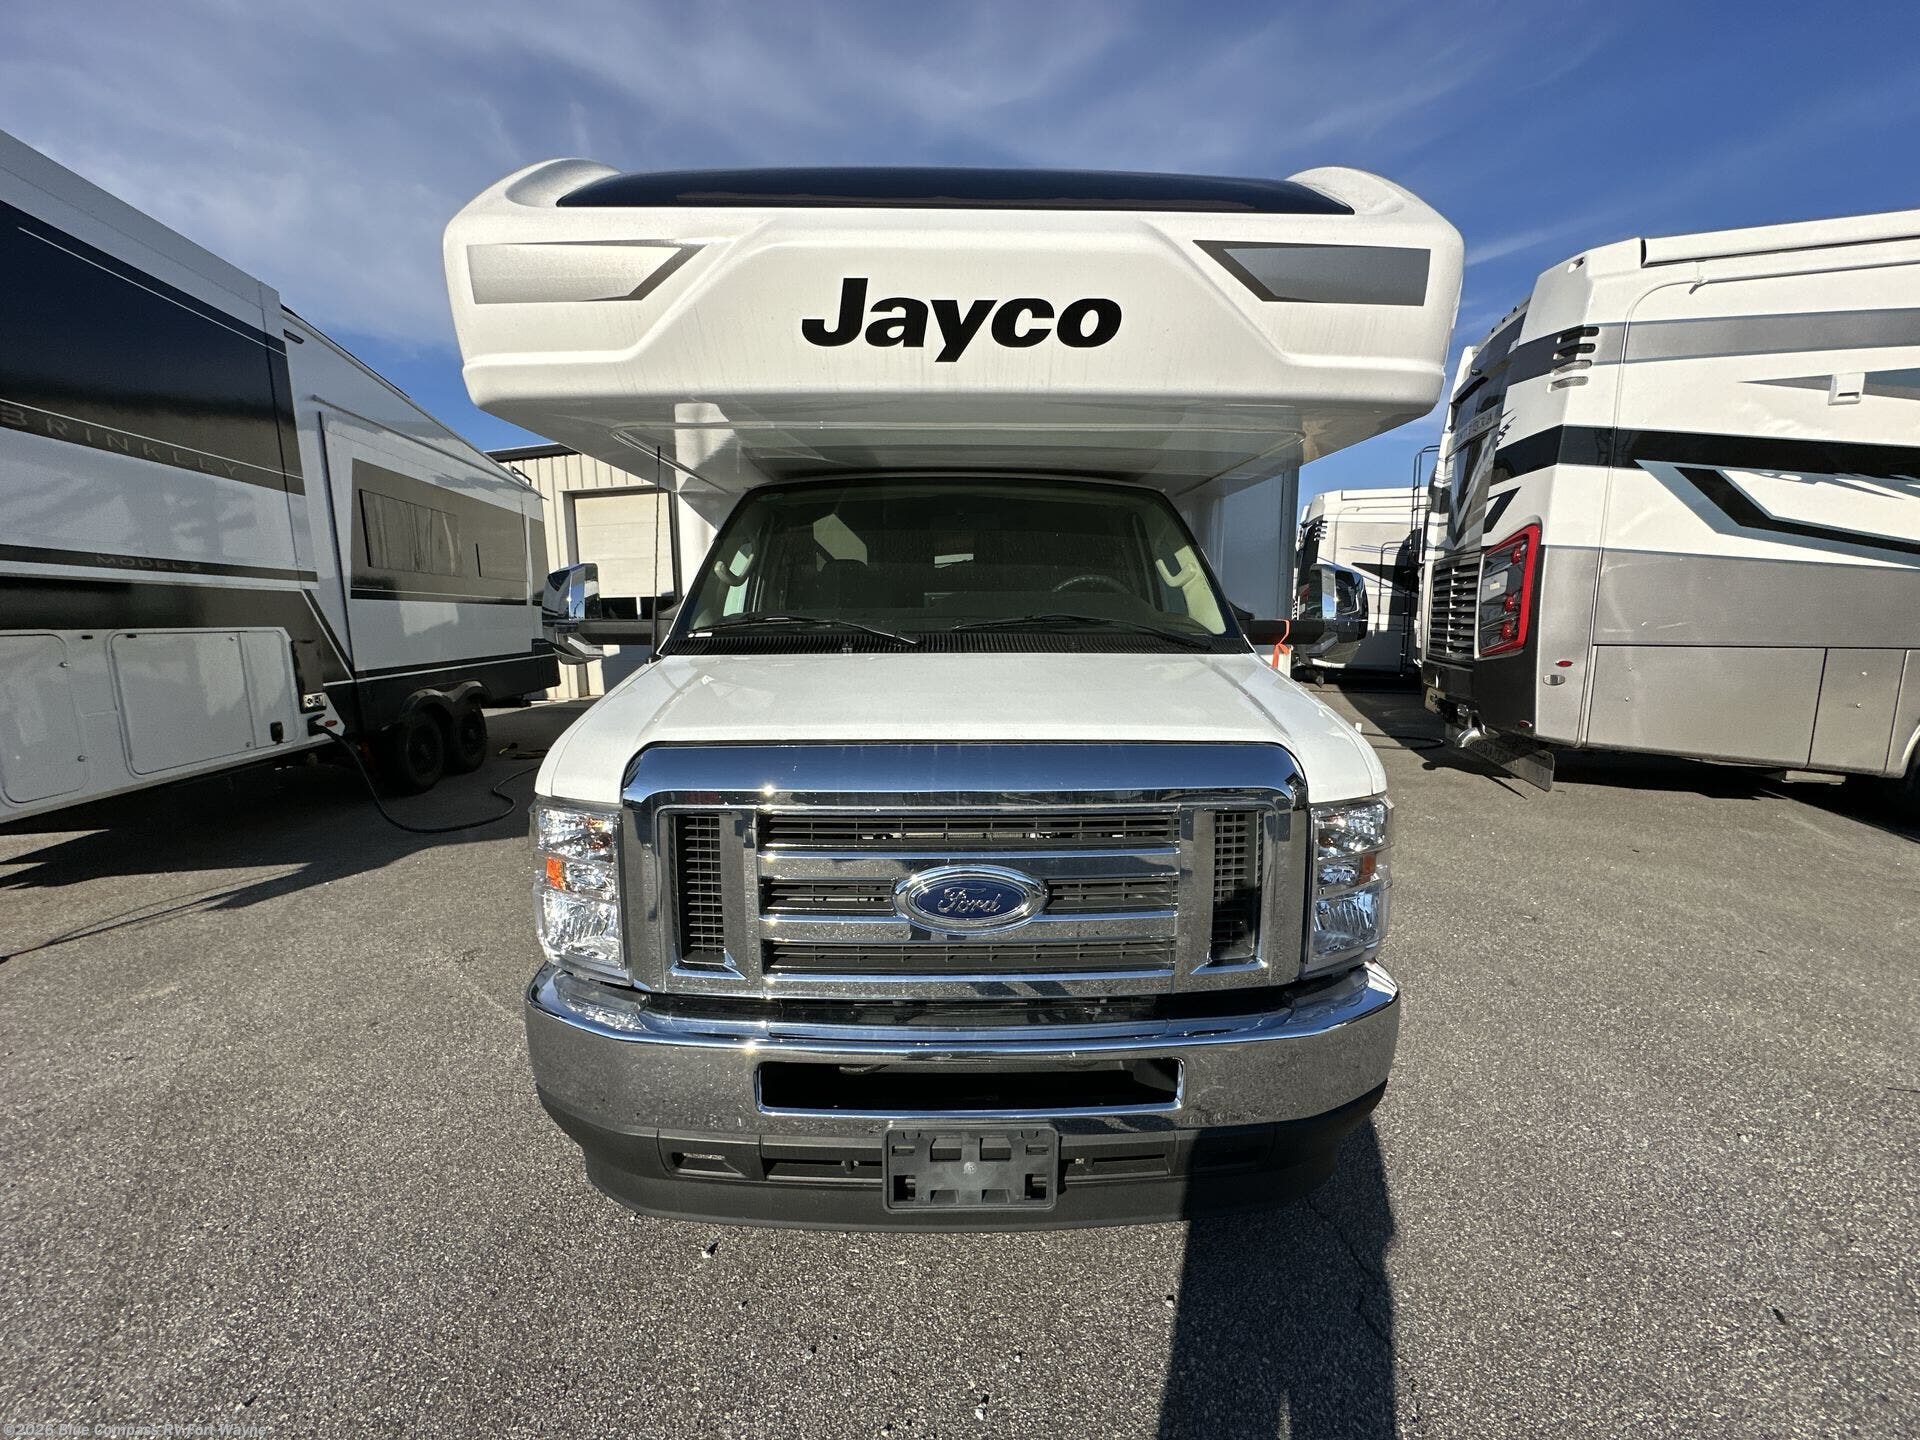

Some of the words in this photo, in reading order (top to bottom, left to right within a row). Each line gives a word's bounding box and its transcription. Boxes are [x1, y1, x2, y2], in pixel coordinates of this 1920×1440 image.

[801, 277, 1122, 363] Jayco
[0, 404, 238, 477] BRINKLEY
[937, 886, 1001, 914] Ford
